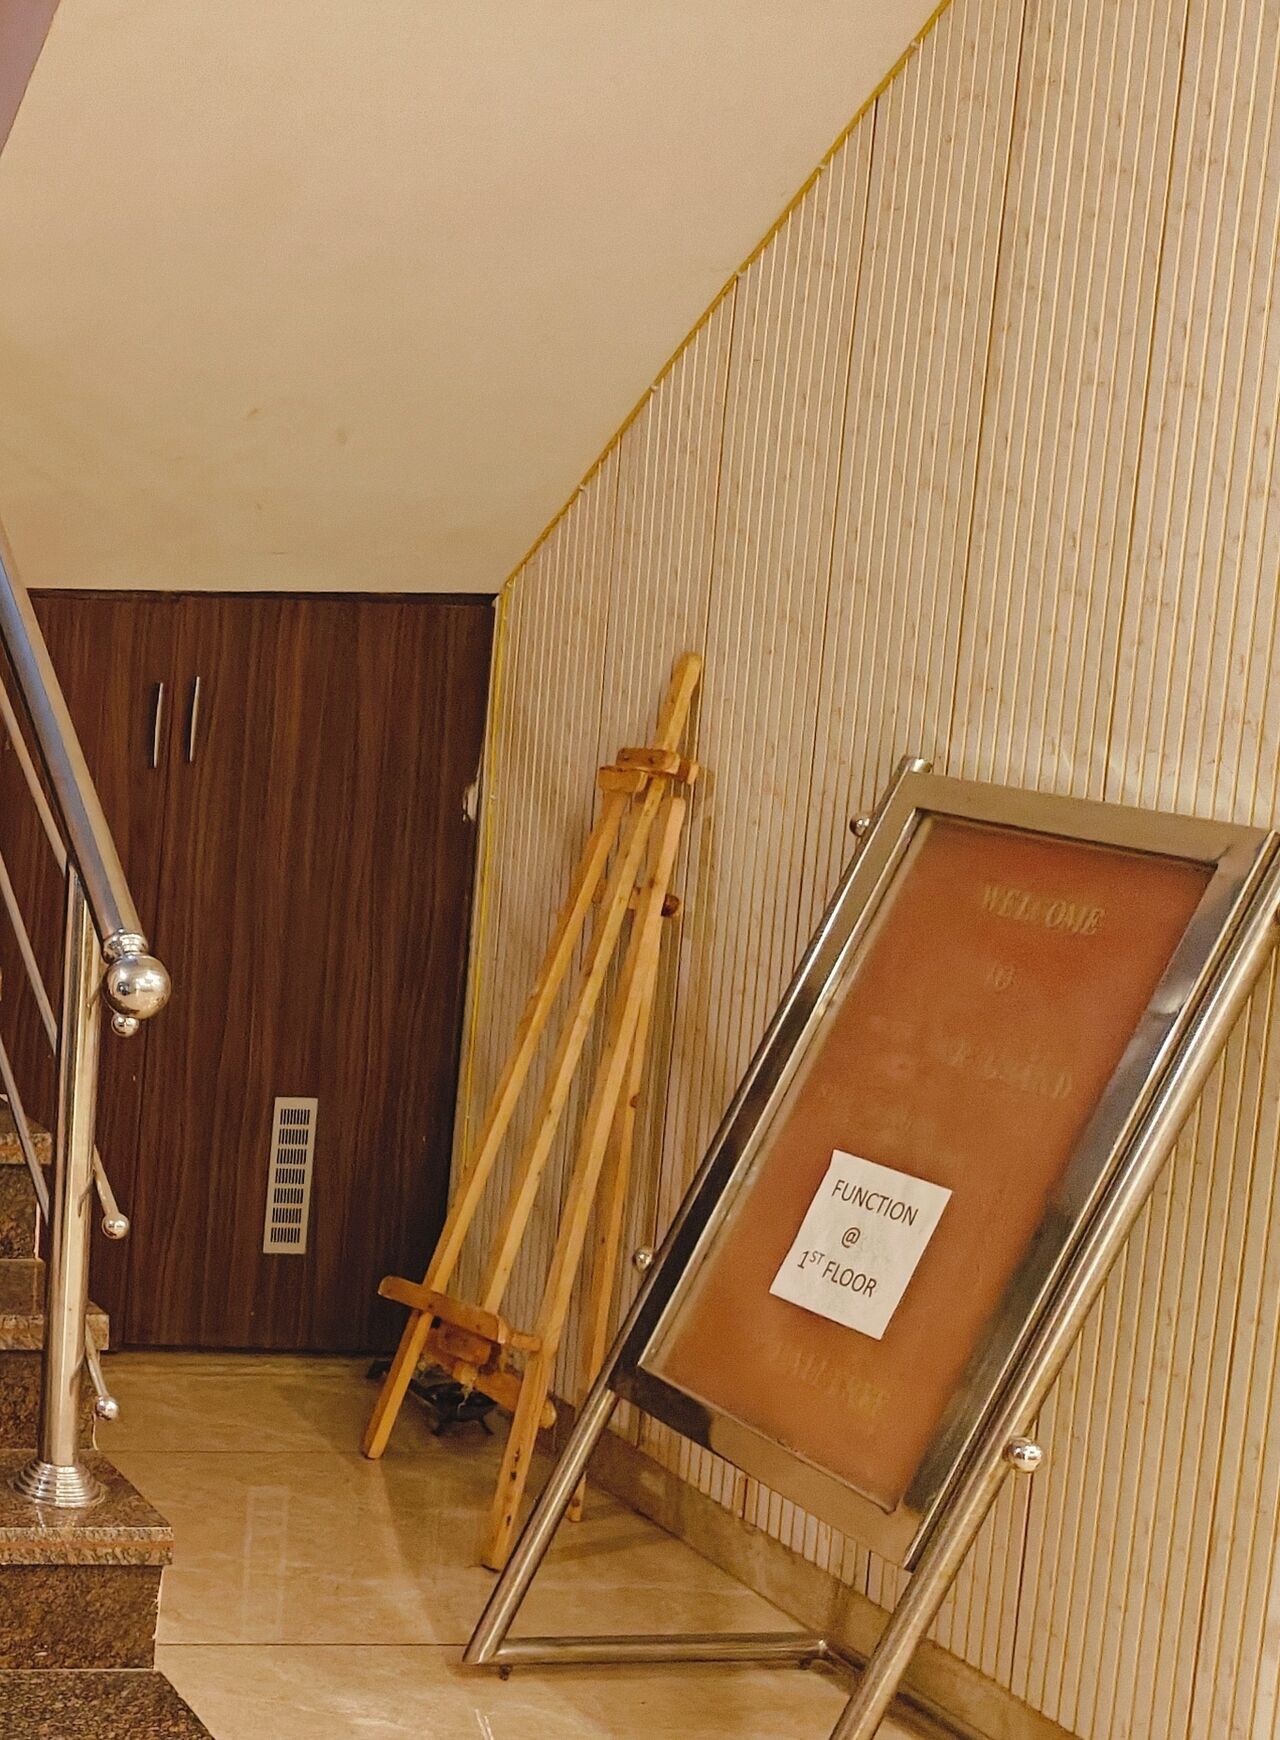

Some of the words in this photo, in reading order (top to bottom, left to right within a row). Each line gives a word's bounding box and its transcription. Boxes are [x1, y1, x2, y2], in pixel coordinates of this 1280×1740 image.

[831, 1179, 919, 1226] FUNCTION
[841, 1227, 860, 1248] @
[797, 1250, 826, 1270] 1ST
[822, 1261, 877, 1298] FLOOR
